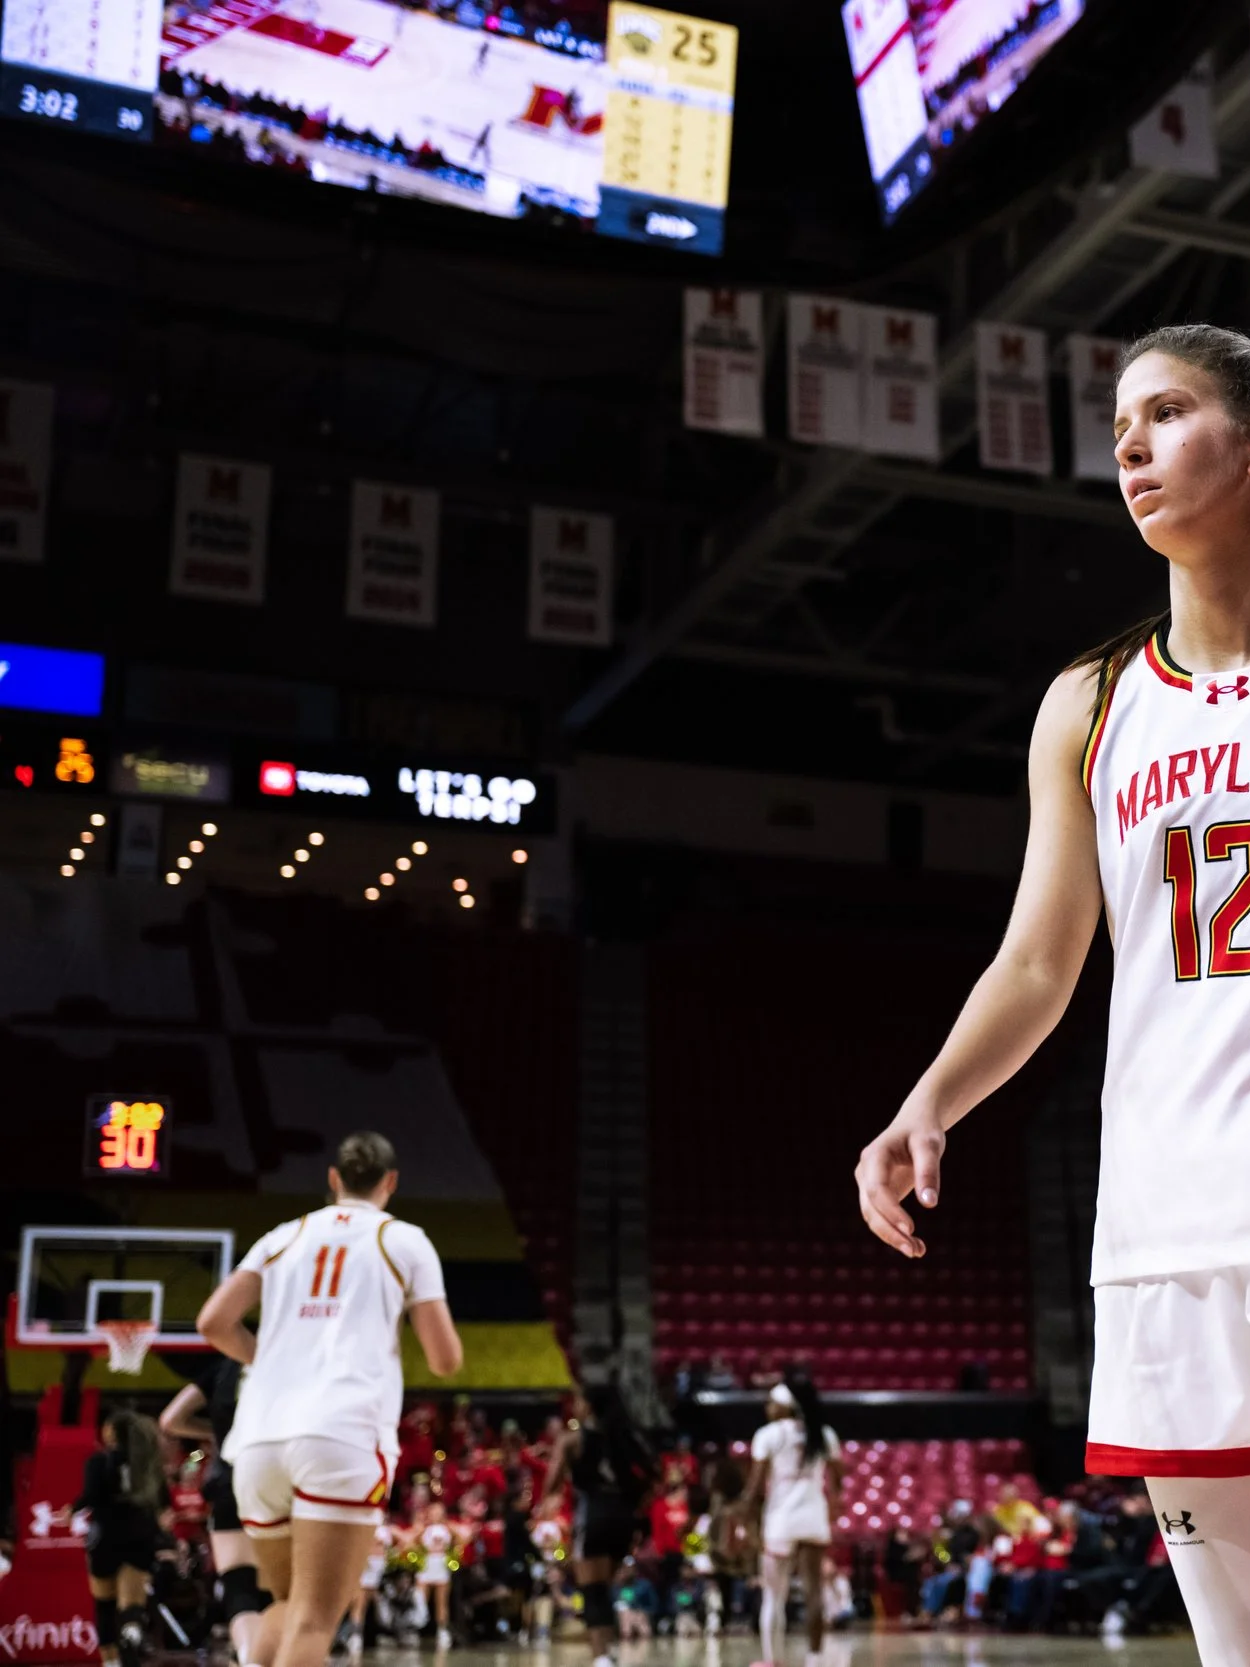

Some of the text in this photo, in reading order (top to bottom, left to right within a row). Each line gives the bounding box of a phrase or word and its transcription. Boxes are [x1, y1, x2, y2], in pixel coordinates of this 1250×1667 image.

[672, 24, 718, 66] 25
[19, 83, 79, 122] 3:02
[99, 1124, 156, 1169] 30
[310, 1243, 348, 1298] 11
